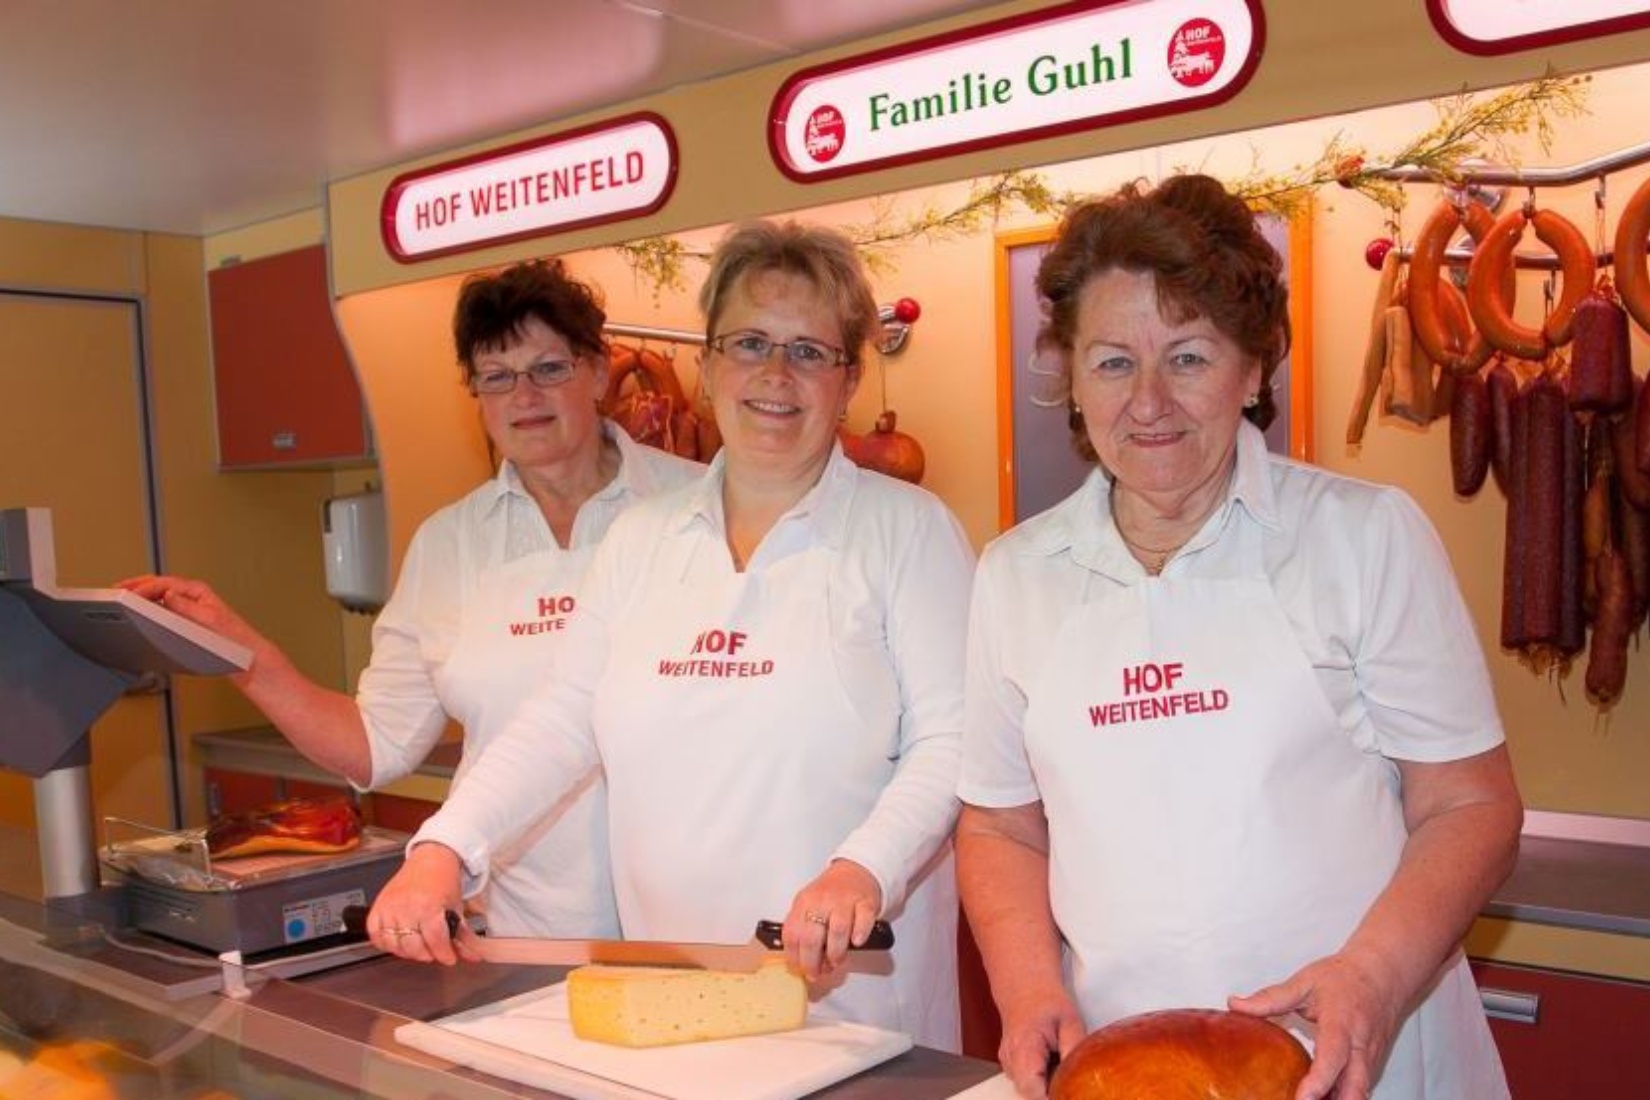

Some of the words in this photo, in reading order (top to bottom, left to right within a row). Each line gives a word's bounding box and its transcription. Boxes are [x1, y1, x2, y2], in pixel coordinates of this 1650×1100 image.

[868, 71, 1013, 132] Familie
[1027, 38, 1134, 97] Guhl
[415, 192, 462, 231] HOF
[470, 150, 645, 218] WEITENFELD
[658, 659, 775, 678] WEITENFELD
[1123, 662, 1184, 696] HOF
[1089, 689, 1230, 727] WEITENFELD
